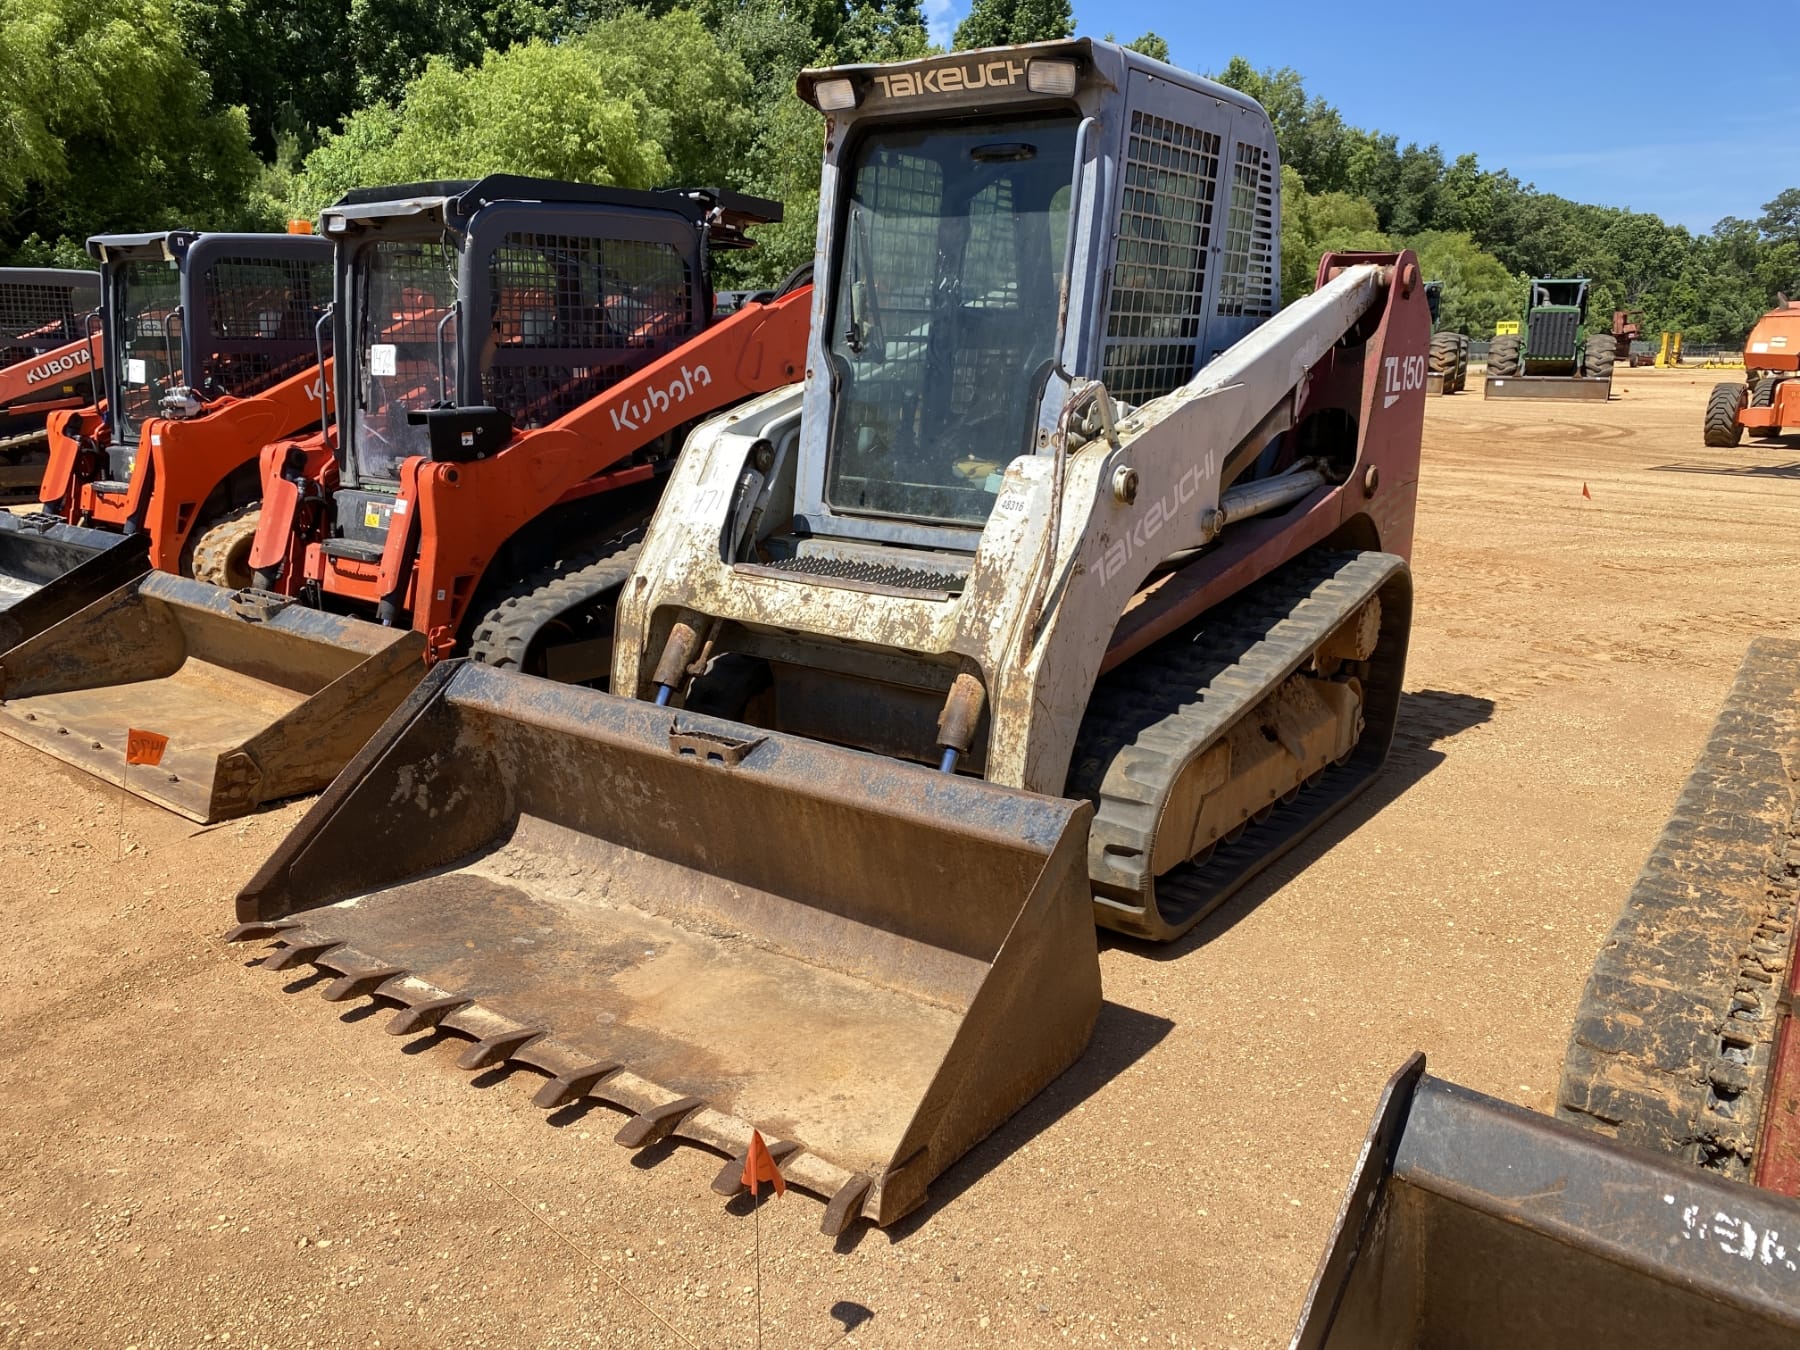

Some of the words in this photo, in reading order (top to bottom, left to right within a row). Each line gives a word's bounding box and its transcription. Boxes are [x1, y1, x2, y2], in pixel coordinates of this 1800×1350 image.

[874, 58, 1030, 99] TAKEUCH
[26, 348, 91, 384] KUBOTA
[609, 365, 712, 431] Kubota
[1001, 500, 1025, 512] 48316
[1090, 449, 1216, 588] TAKEUCHI
